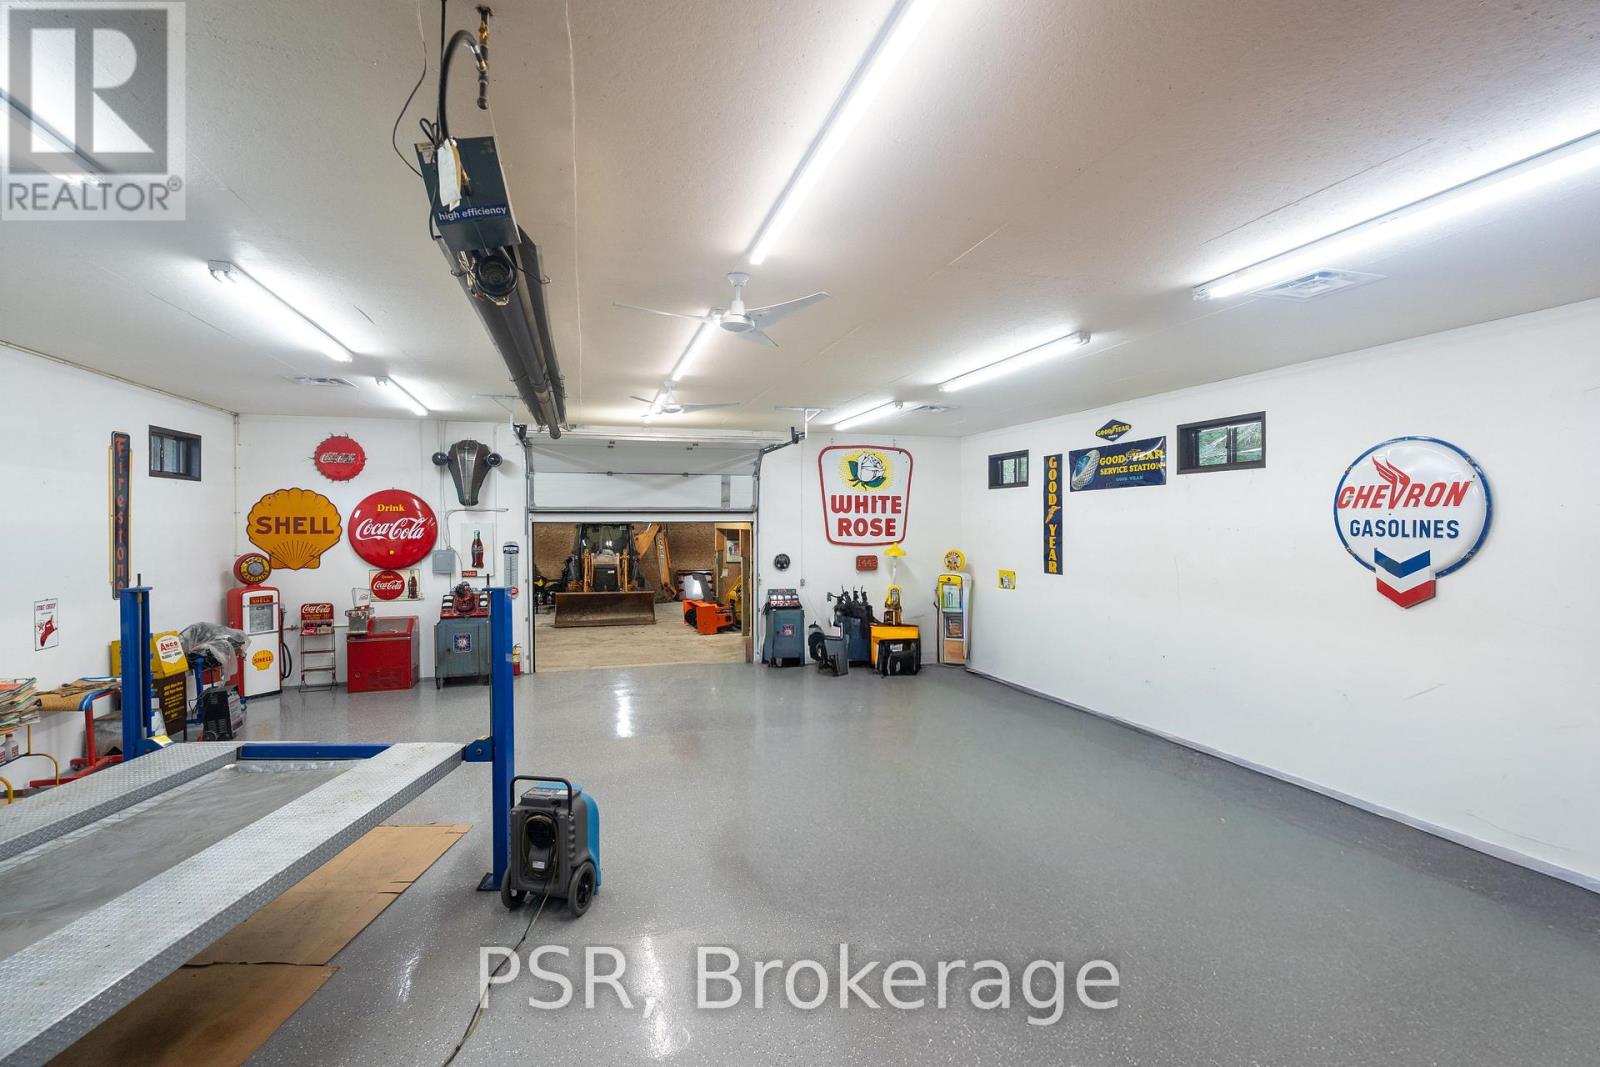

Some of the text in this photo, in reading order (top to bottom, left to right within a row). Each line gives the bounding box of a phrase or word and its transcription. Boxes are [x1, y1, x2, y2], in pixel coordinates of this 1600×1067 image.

[438, 206, 506, 221] high efficiency
[1100, 449, 1164, 465] GOOD YEAR
[1100, 462, 1165, 475] SERVICE STATION
[1337, 471, 1471, 510] CHEVRON
[377, 503, 405, 512] Drink
[831, 495, 902, 514] WHITE
[255, 516, 334, 535] SHELL
[355, 517, 427, 540] Coca-Cola
[837, 518, 896, 537] ROSE
[1350, 519, 1460, 539] GASOLINES
